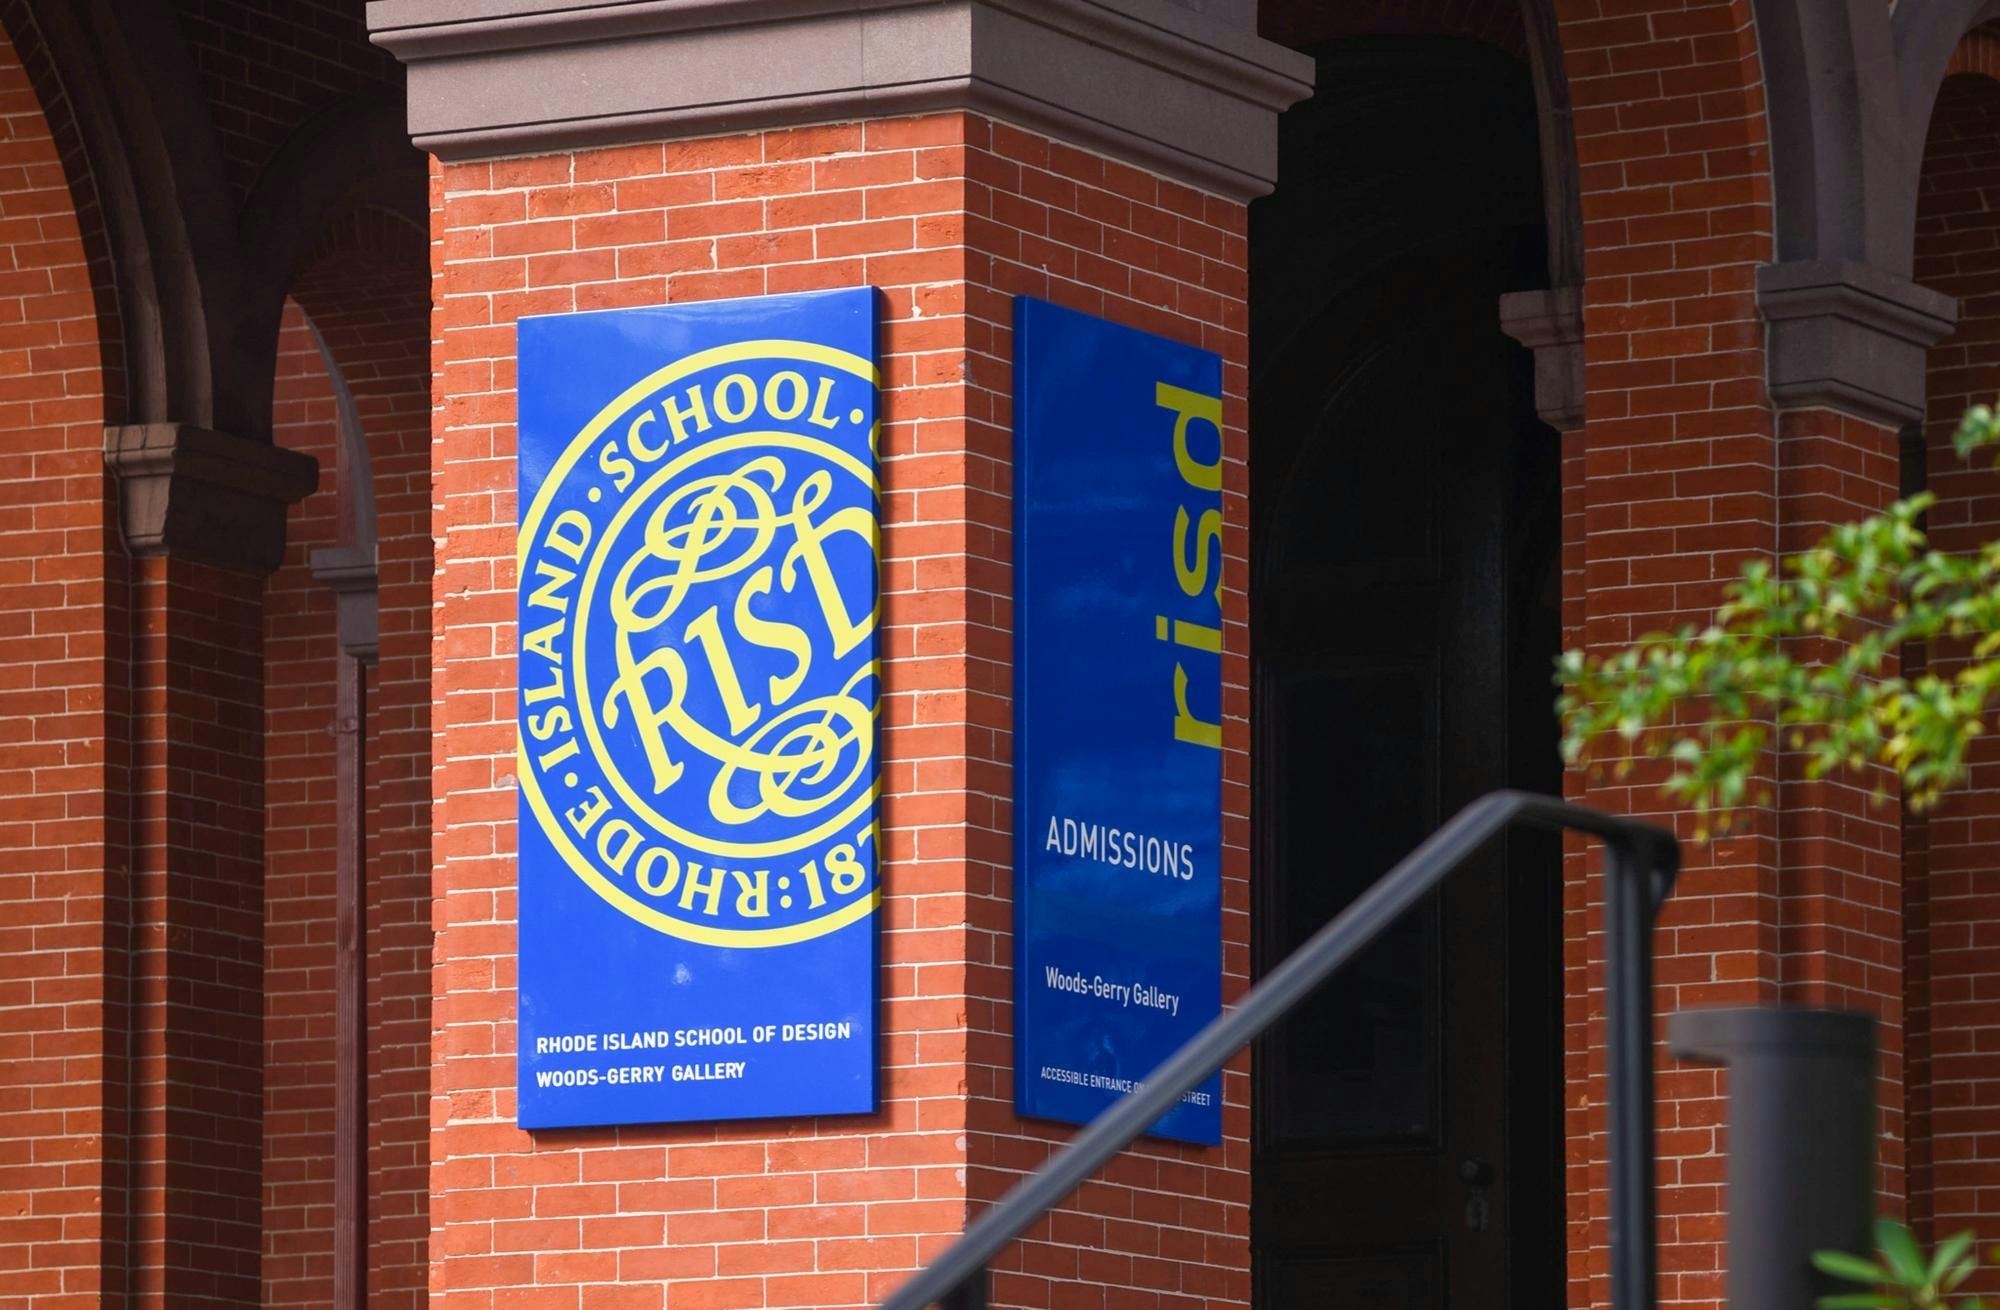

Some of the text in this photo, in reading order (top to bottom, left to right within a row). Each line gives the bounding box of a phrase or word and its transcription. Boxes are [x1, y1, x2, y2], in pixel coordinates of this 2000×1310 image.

[1156, 381, 1223, 749] risd
[523, 371, 840, 918] RHODE ISLAND SCHOOL
[603, 456, 881, 825] RISD
[1046, 815, 1194, 880] ADMISSIONS
[1045, 965, 1179, 1017] Woods-Gerry Gallery
[536, 1022, 850, 1055] RHODE ISLAND SCHOOL OF DESIGN
[536, 1062, 746, 1088] WOODS-GERRY GALLERY
[1040, 1066, 1088, 1087] ACCESSIBLE
[1090, 1074, 1132, 1094] ENTRANCE
[1182, 1091, 1211, 1107] STREET
